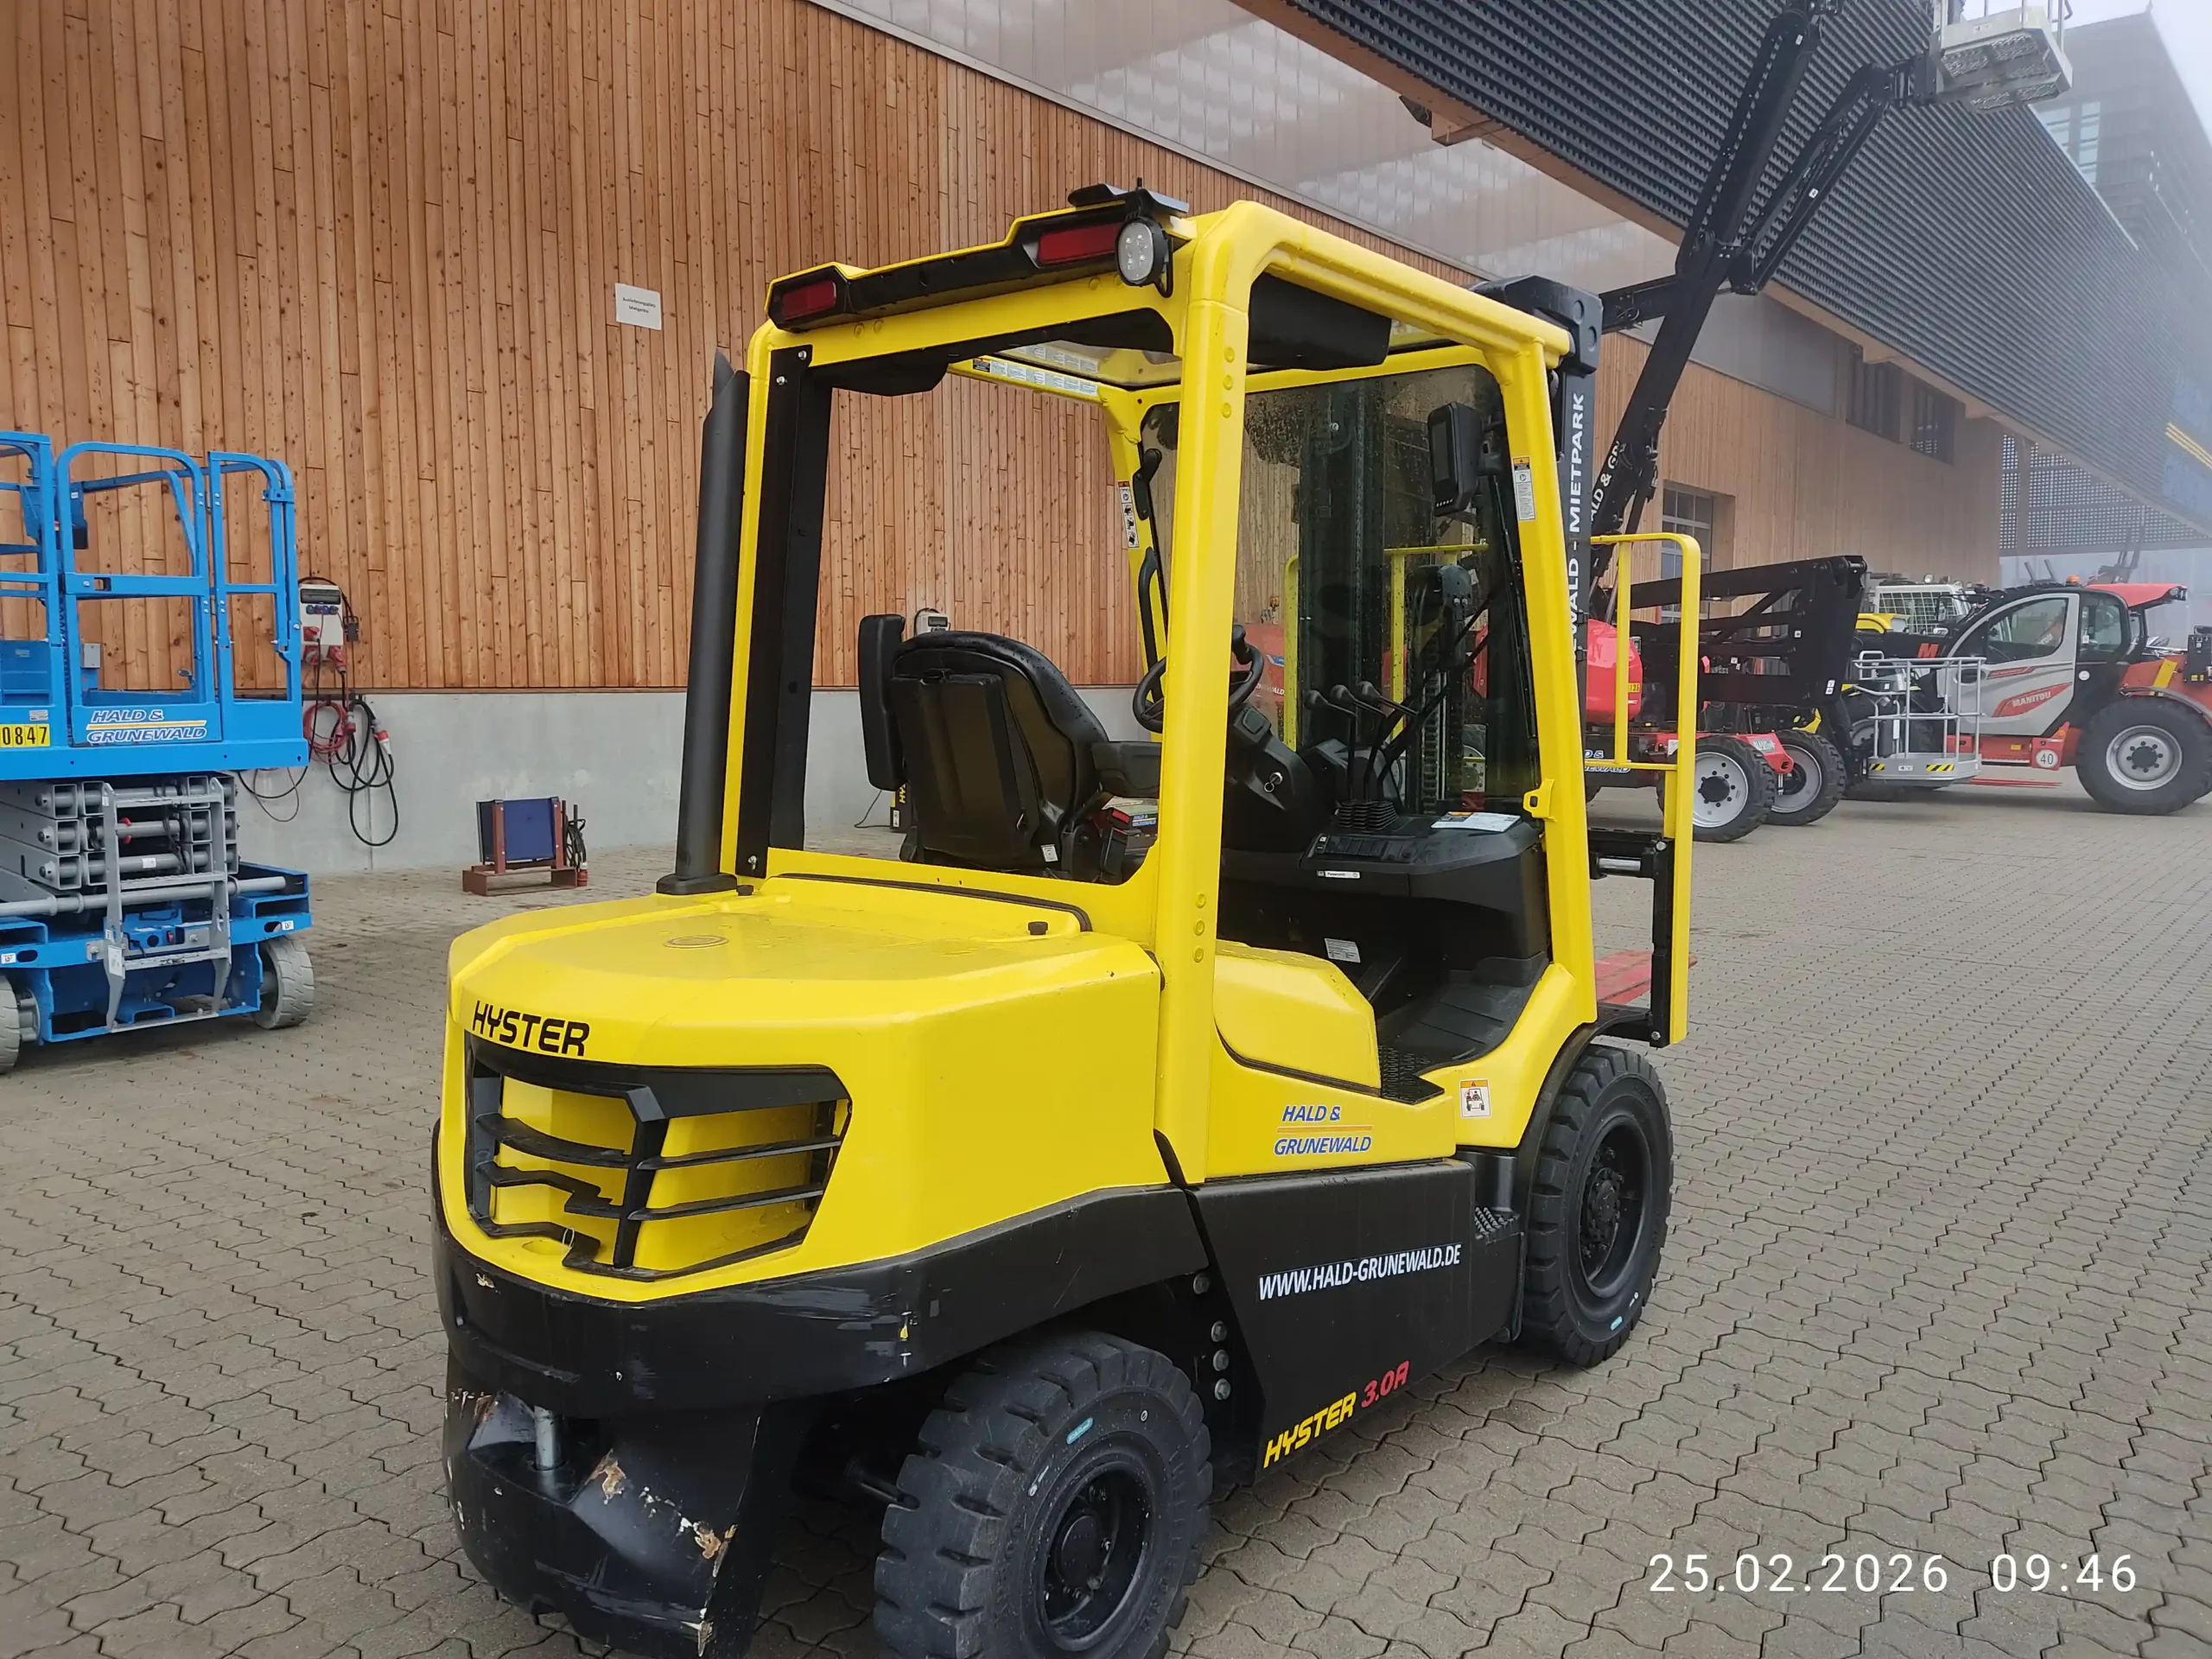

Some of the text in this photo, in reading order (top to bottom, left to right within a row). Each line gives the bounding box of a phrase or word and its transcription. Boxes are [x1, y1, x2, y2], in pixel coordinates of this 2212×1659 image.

[1569, 393, 1584, 533] MIETPARK
[1600, 474, 1611, 486] &
[2012, 691, 2051, 708] MANITOU
[92, 709, 164, 723] HALD &
[2, 726, 48, 746] 0847
[86, 727, 207, 744] GRUNEWALD
[2040, 753, 2055, 765] 40
[473, 1000, 589, 1057] HYSTER
[1281, 1105, 1341, 1122] HALD &
[1274, 1136, 1372, 1155] GRUNEWALD
[1259, 1243, 1462, 1301] WWW.HALD-GRUNEWALD.DE
[1263, 1391, 1357, 1469] HYSTER
